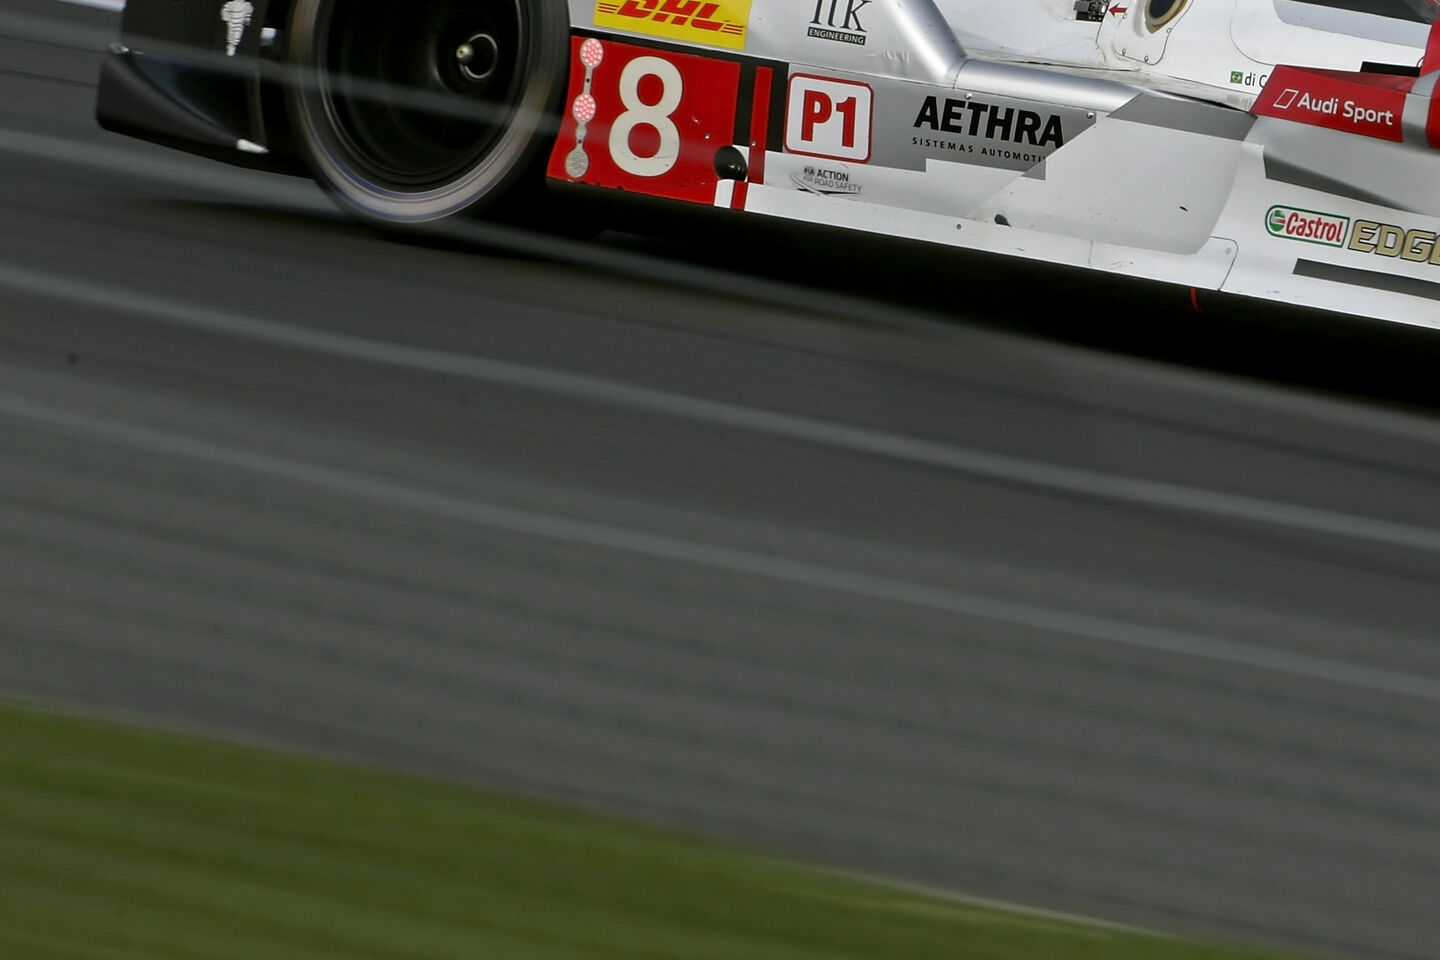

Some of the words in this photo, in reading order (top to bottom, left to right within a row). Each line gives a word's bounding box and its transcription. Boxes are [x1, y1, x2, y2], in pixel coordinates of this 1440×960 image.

[808, 28, 865, 44] ENGINEERING
[1244, 72, 1256, 87] di
[608, 56, 683, 177] 8
[801, 91, 858, 148] P1
[913, 96, 1064, 149] AETHRA
[1297, 93, 1338, 115] Audi
[1343, 102, 1394, 126] Sport
[912, 137, 974, 153] SISTEMAS
[981, 147, 1046, 163] AUTOMOTI
[814, 178, 834, 188] ROAD
[835, 182, 862, 192] SAFETY
[817, 169, 849, 182] ACTION
[1285, 212, 1343, 243] Castrol
